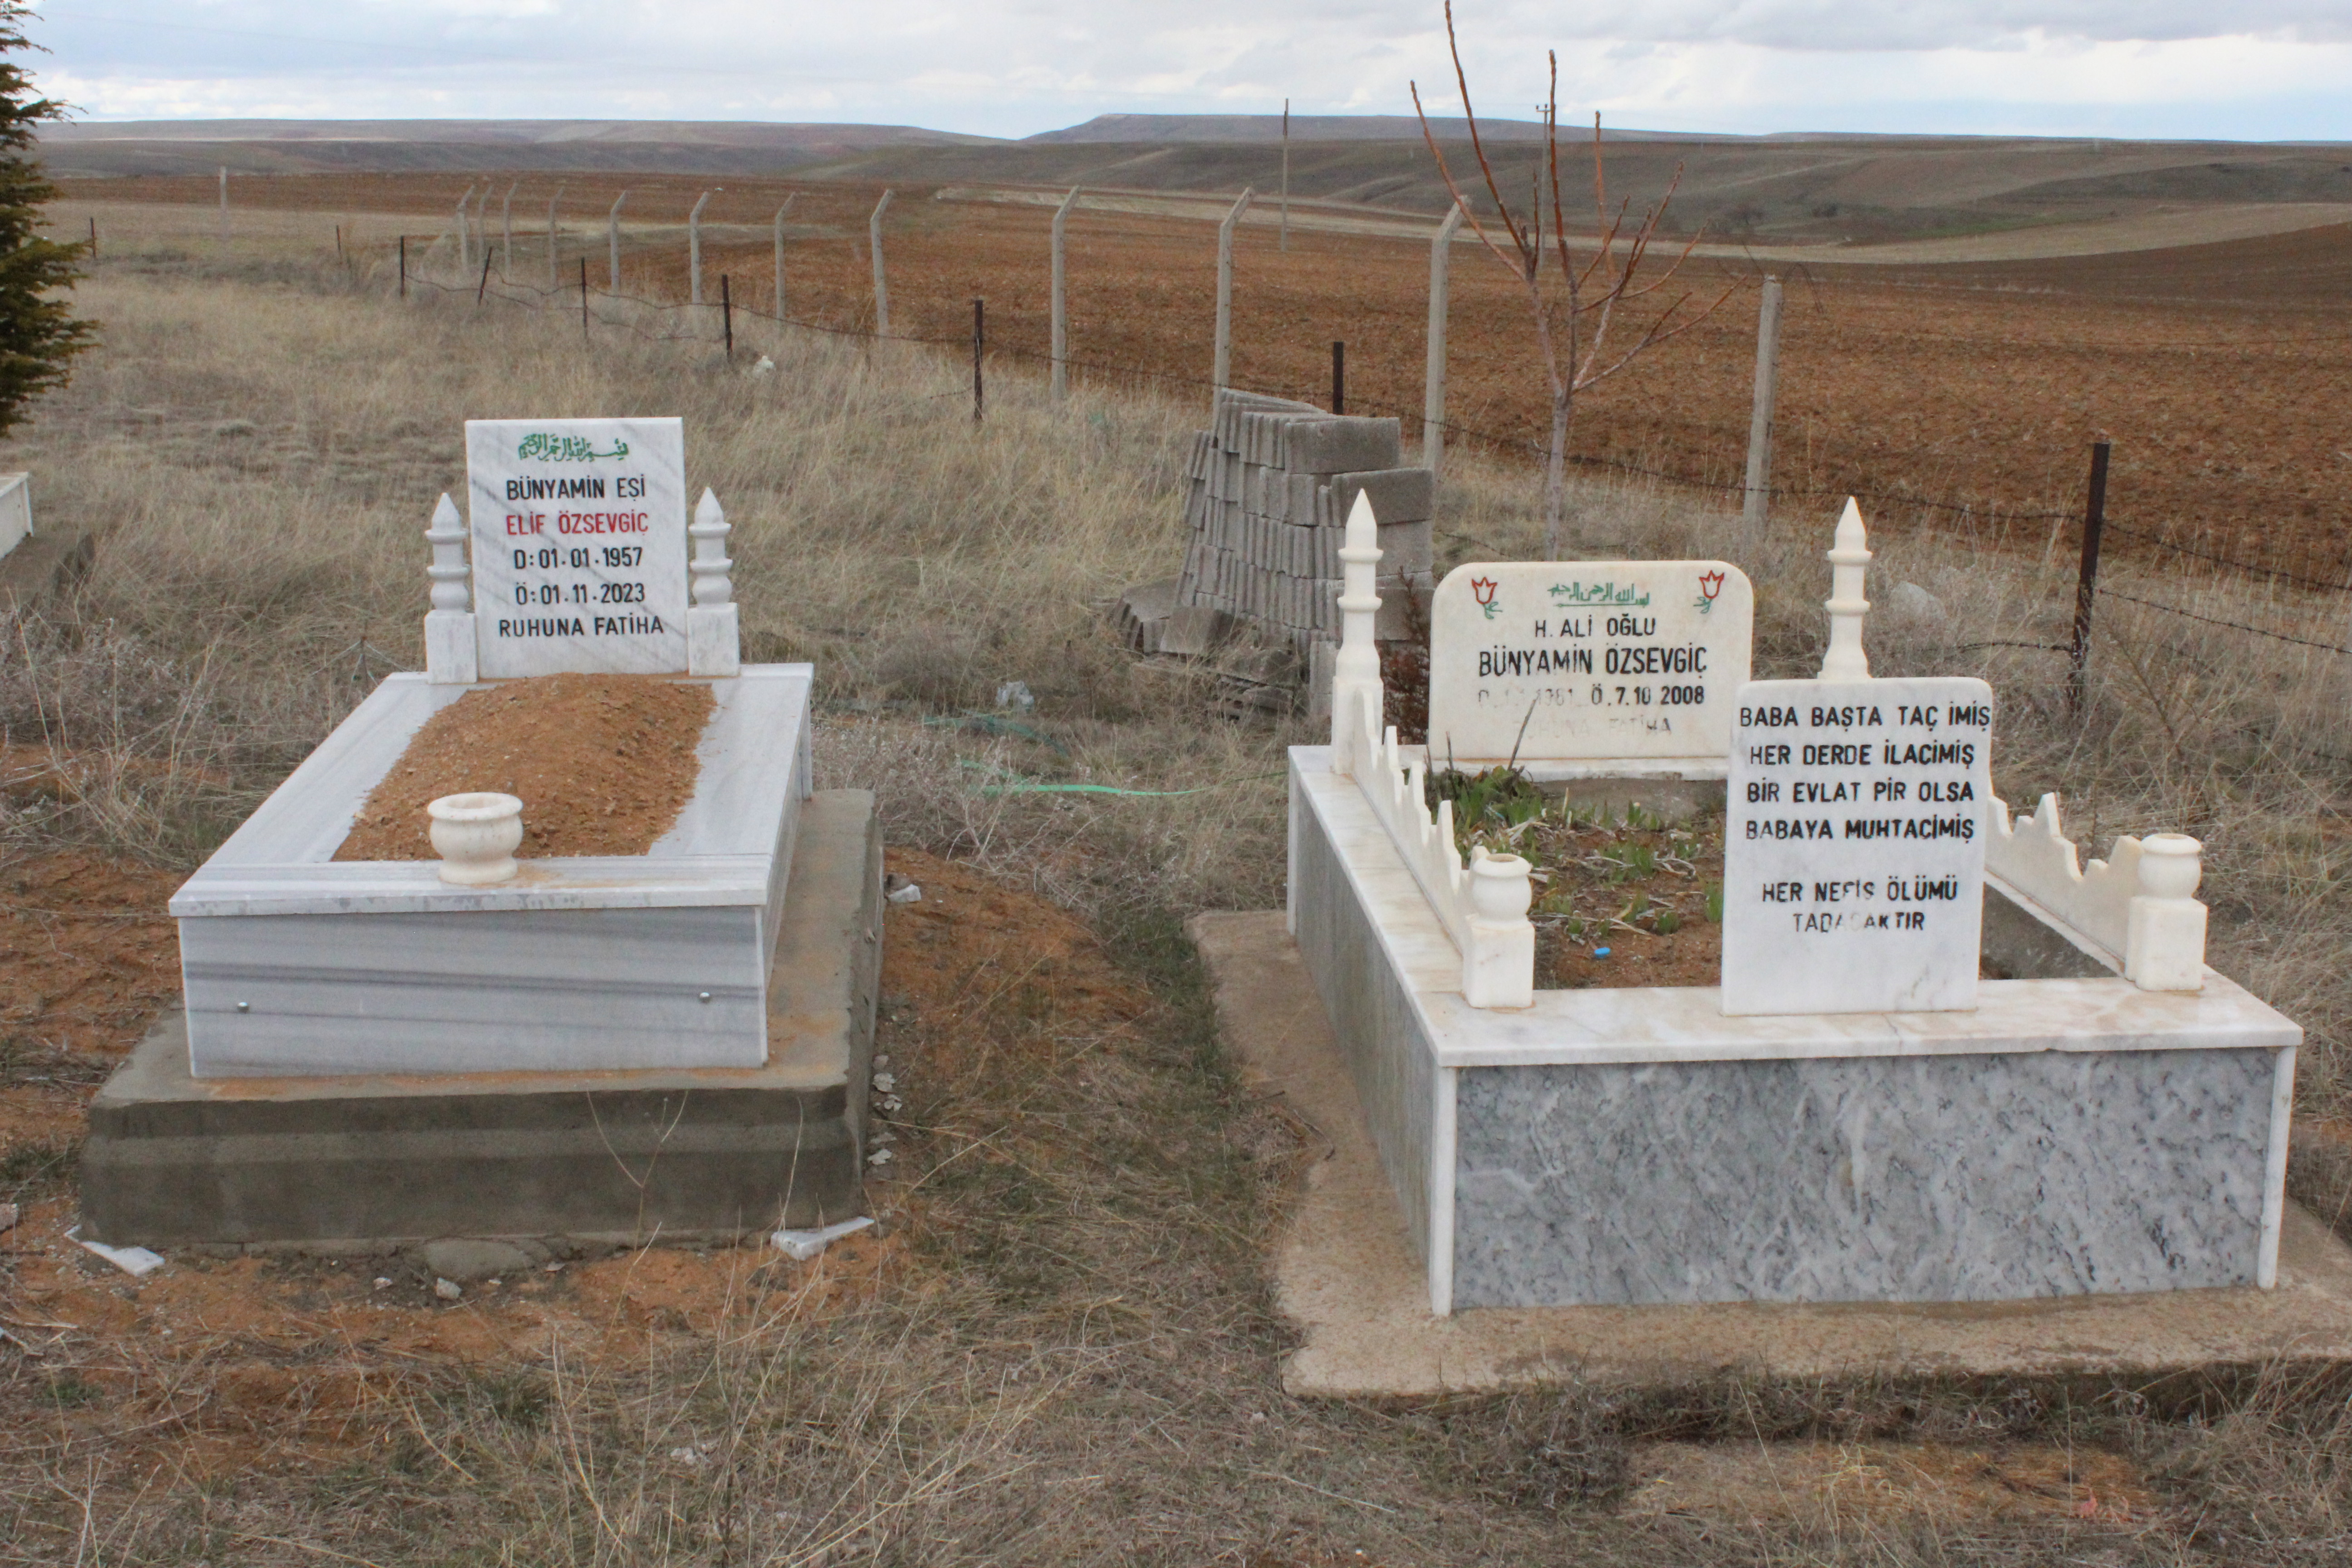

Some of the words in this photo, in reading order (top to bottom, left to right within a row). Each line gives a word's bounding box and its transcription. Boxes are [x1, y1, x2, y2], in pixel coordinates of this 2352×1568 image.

[506, 475, 605, 501] BÜNYAMİN
[616, 473, 646, 501] EŞİ
[506, 511, 546, 536] ELİF
[558, 509, 648, 534] ÖZSEVGİÇ
[499, 617, 585, 637] RUHUNA
[593, 612, 664, 636] FATİHA
[1534, 619, 1553, 638] H.
[1559, 614, 1592, 638] ALİ
[1606, 613, 1656, 637] OĞLU
[1479, 643, 1593, 677] BÜNYAMİN
[1604, 642, 1707, 679] ÖZSEVGİÇ
[1740, 706, 1799, 727] BABA
[1810, 706, 1883, 732] BAŞTA
[1897, 705, 1939, 732] TAÇ
[1948, 700, 1991, 732] İMİŞ
[1750, 744, 1791, 766] HER
[1802, 744, 1872, 766] DERDE
[1883, 739, 1975, 770] İLACİMİŞ
[1747, 777, 1780, 804] BİR
[1792, 781, 1862, 804] EVLAT
[1873, 776, 1907, 802] PİR
[1918, 781, 1975, 803] OLSA
[1746, 819, 1834, 840] BABAYA
[1844, 813, 1975, 844] MUHTACİMİŞ
[1762, 882, 1804, 903] HER
[1887, 874, 1959, 902] ÖLÜMÜ
